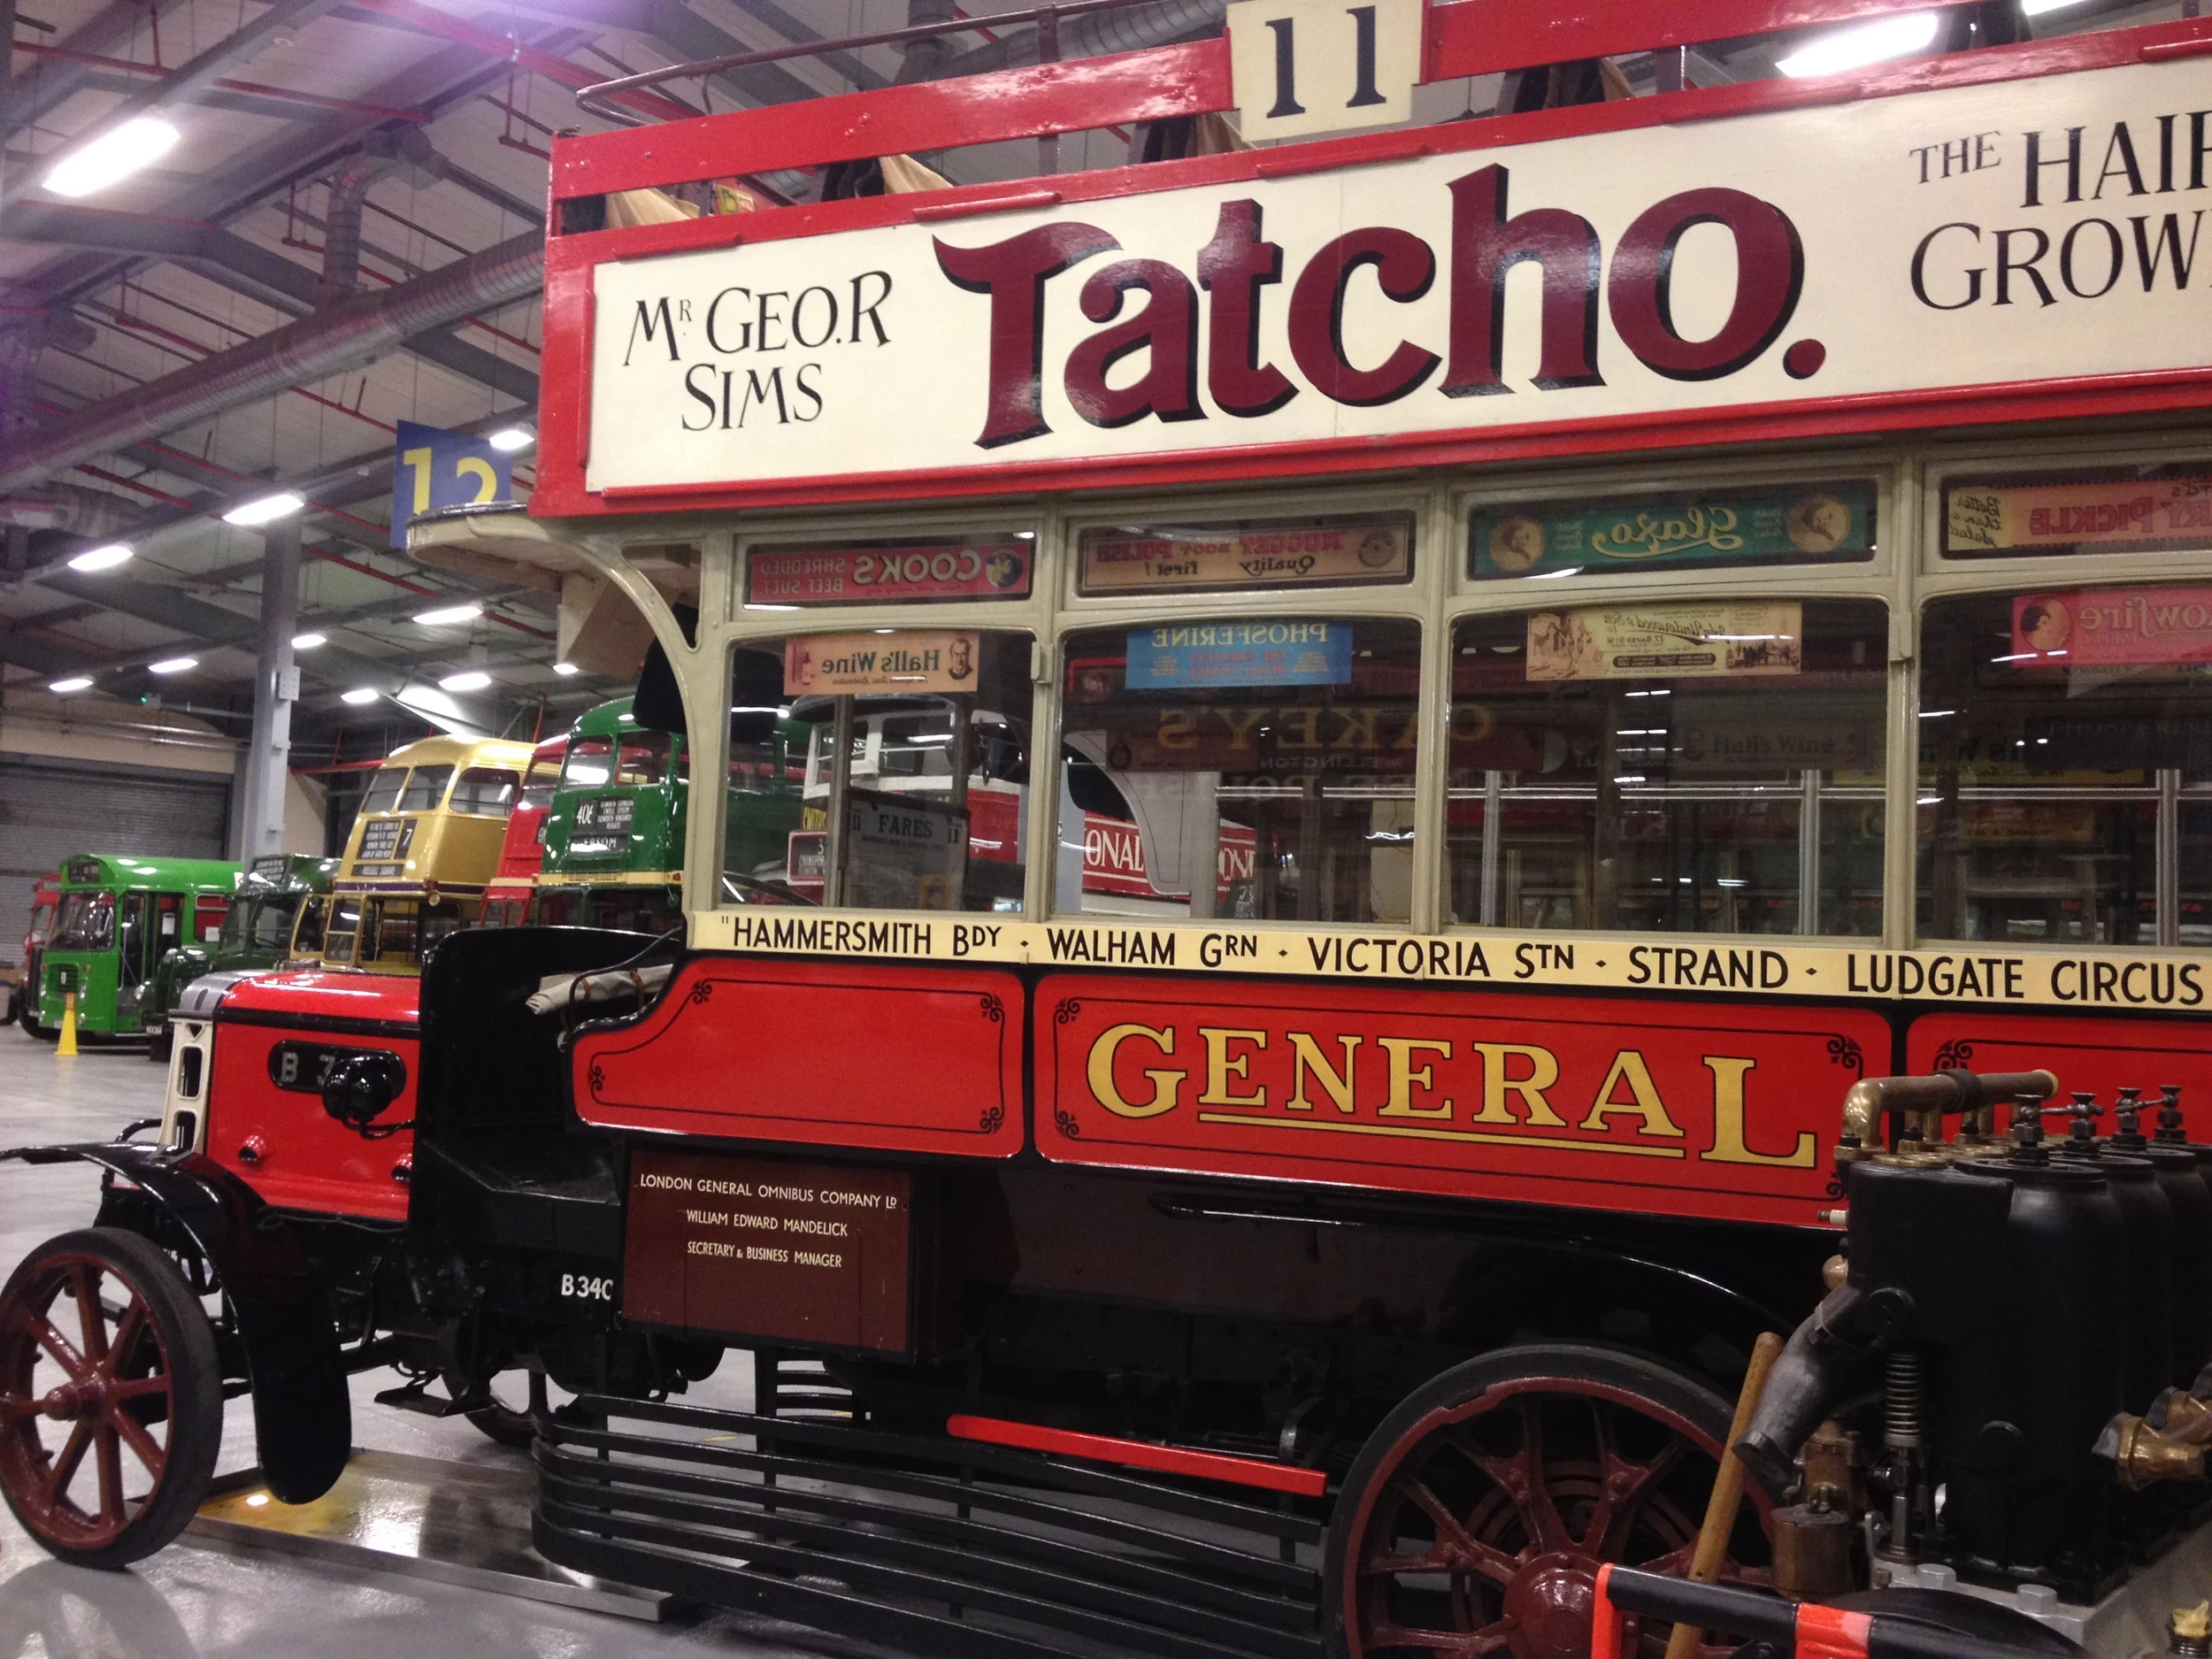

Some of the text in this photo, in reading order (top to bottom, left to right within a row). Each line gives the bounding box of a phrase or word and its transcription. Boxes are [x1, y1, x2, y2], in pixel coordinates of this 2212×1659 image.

[1265, 5, 1386, 119] 11
[1909, 130, 2002, 184] THE
[1910, 210, 2212, 311] GROW
[932, 163, 1826, 449] Tatcho.
[681, 362, 823, 432] SIMS
[403, 447, 496, 516] 12
[403, 828, 413, 846] 7
[879, 814, 933, 839] FARES
[1084, 829, 1144, 872] ONAL
[1047, 928, 1175, 966] WALHAM
[1201, 933, 1257, 968] GRN
[1307, 936, 1491, 978] VICTORIA
[1514, 942, 1574, 979] STN
[1626, 945, 1789, 989] STRAND
[1847, 953, 2024, 999] LUDGATE
[2051, 959, 2204, 1006] CIRCUS
[1086, 1021, 1819, 1170] GENERAL
[640, 1173, 693, 1192] LONDON
[696, 1179, 752, 1197] GENERAL
[757, 1185, 814, 1202] OMNIBUS
[820, 1189, 881, 1210] COMPANY
[687, 1209, 849, 1237] WILLIAM EDWARD MANDELICK
[687, 1240, 842, 1269] SECRETARY & BUSINESS MANAGER
